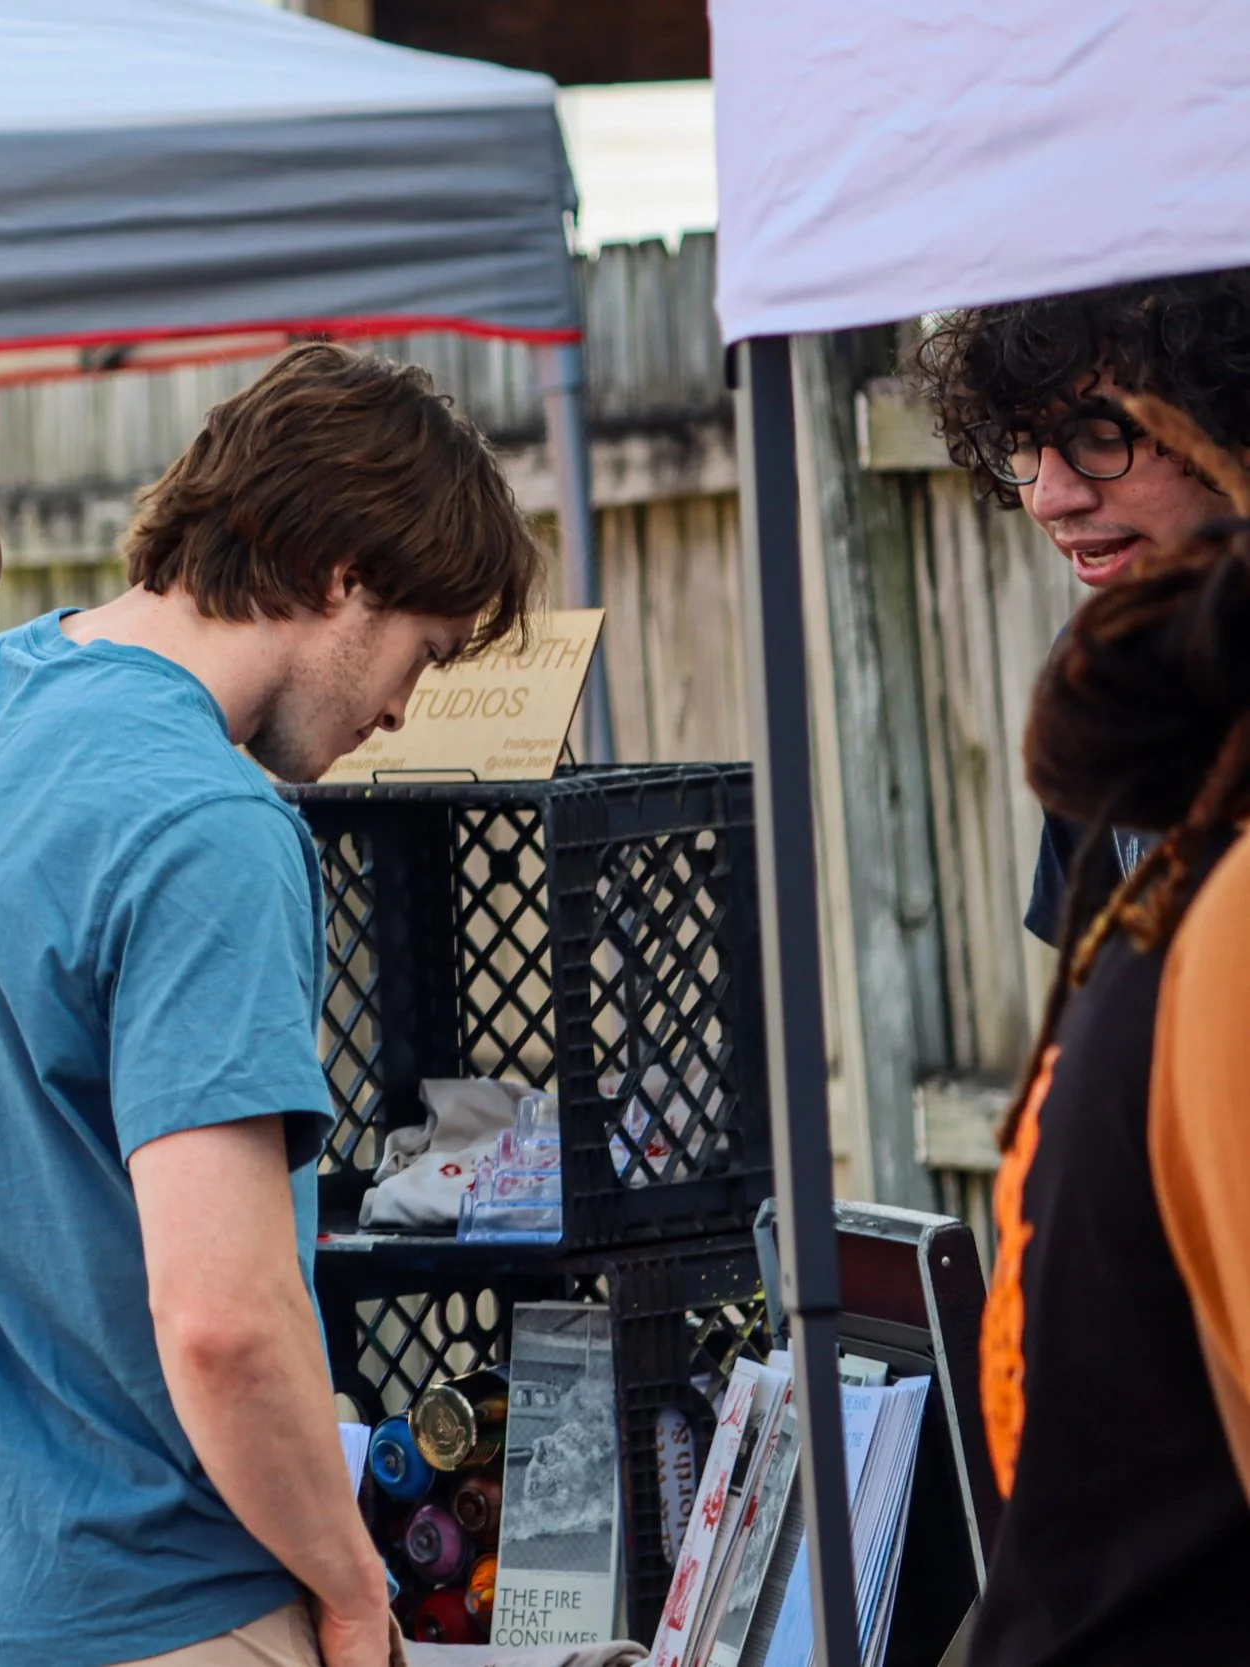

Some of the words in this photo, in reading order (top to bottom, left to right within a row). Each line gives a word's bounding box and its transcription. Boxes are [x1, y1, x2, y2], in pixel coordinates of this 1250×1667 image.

[410, 686, 530, 720] TUDIOS
[502, 735, 558, 753] Instagram
[499, 1587, 539, 1607] THE
[544, 1589, 582, 1609] FIRE
[497, 1607, 552, 1628] THAT
